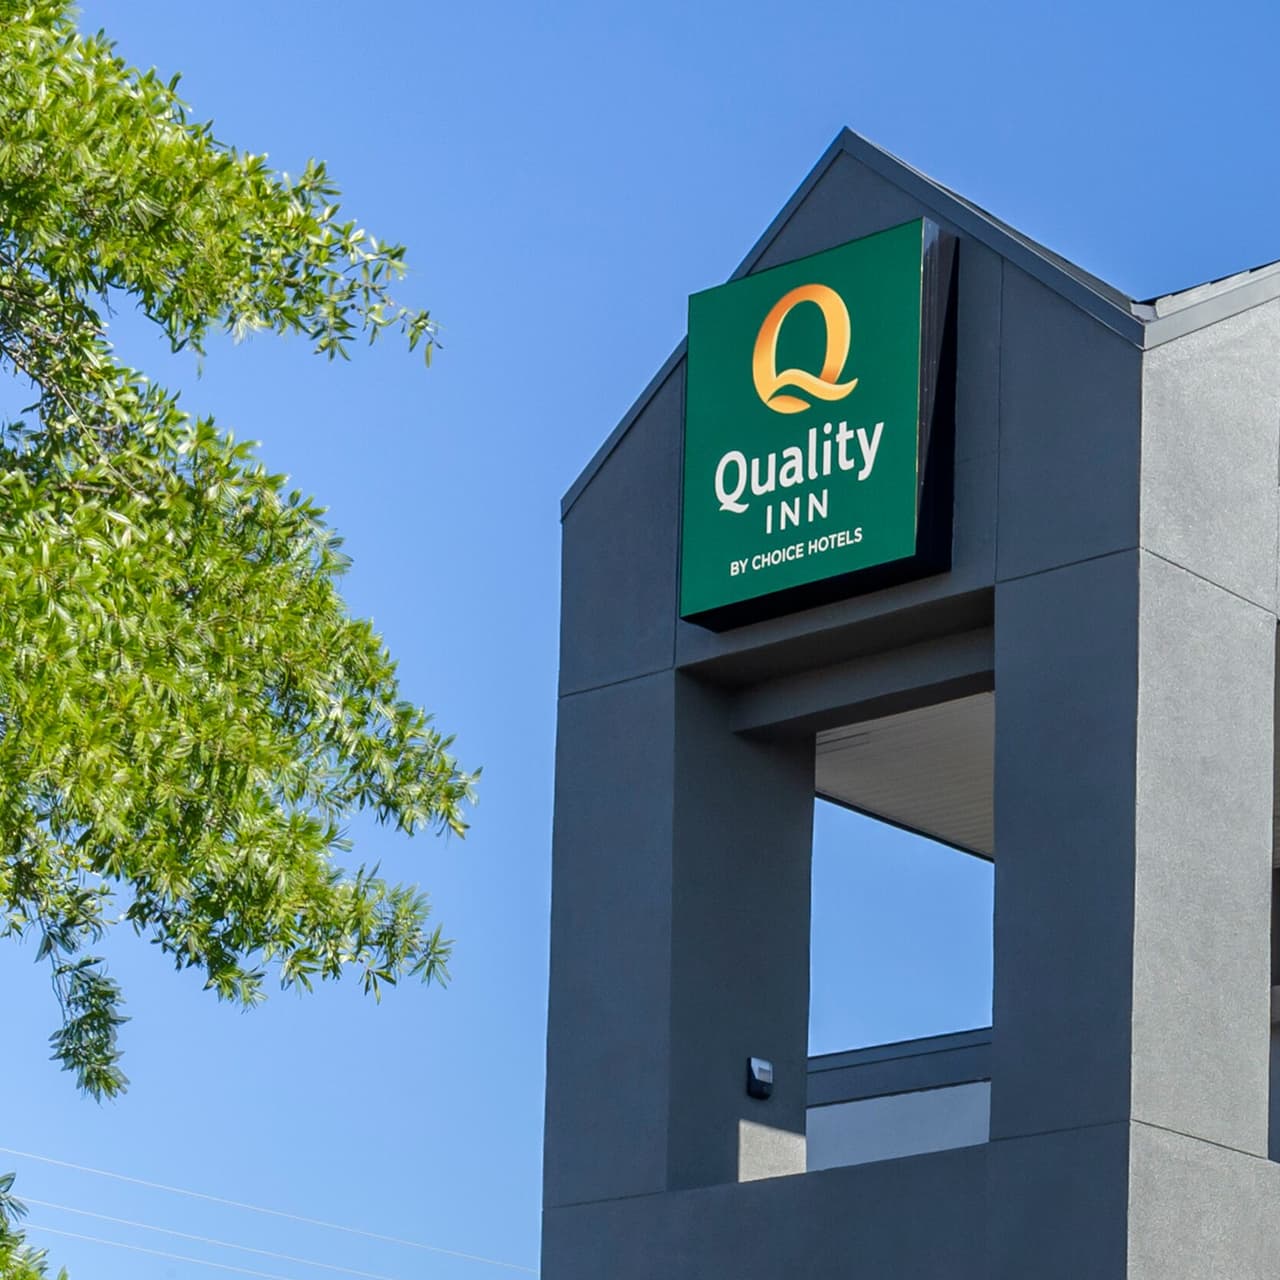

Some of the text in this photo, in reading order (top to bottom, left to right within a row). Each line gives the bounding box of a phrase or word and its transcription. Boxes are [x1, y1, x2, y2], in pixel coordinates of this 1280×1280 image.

[752, 283, 858, 414] Q
[714, 421, 884, 513] Quality
[766, 489, 828, 534] INN
[730, 527, 863, 576] BY CHOICE HOTELS
